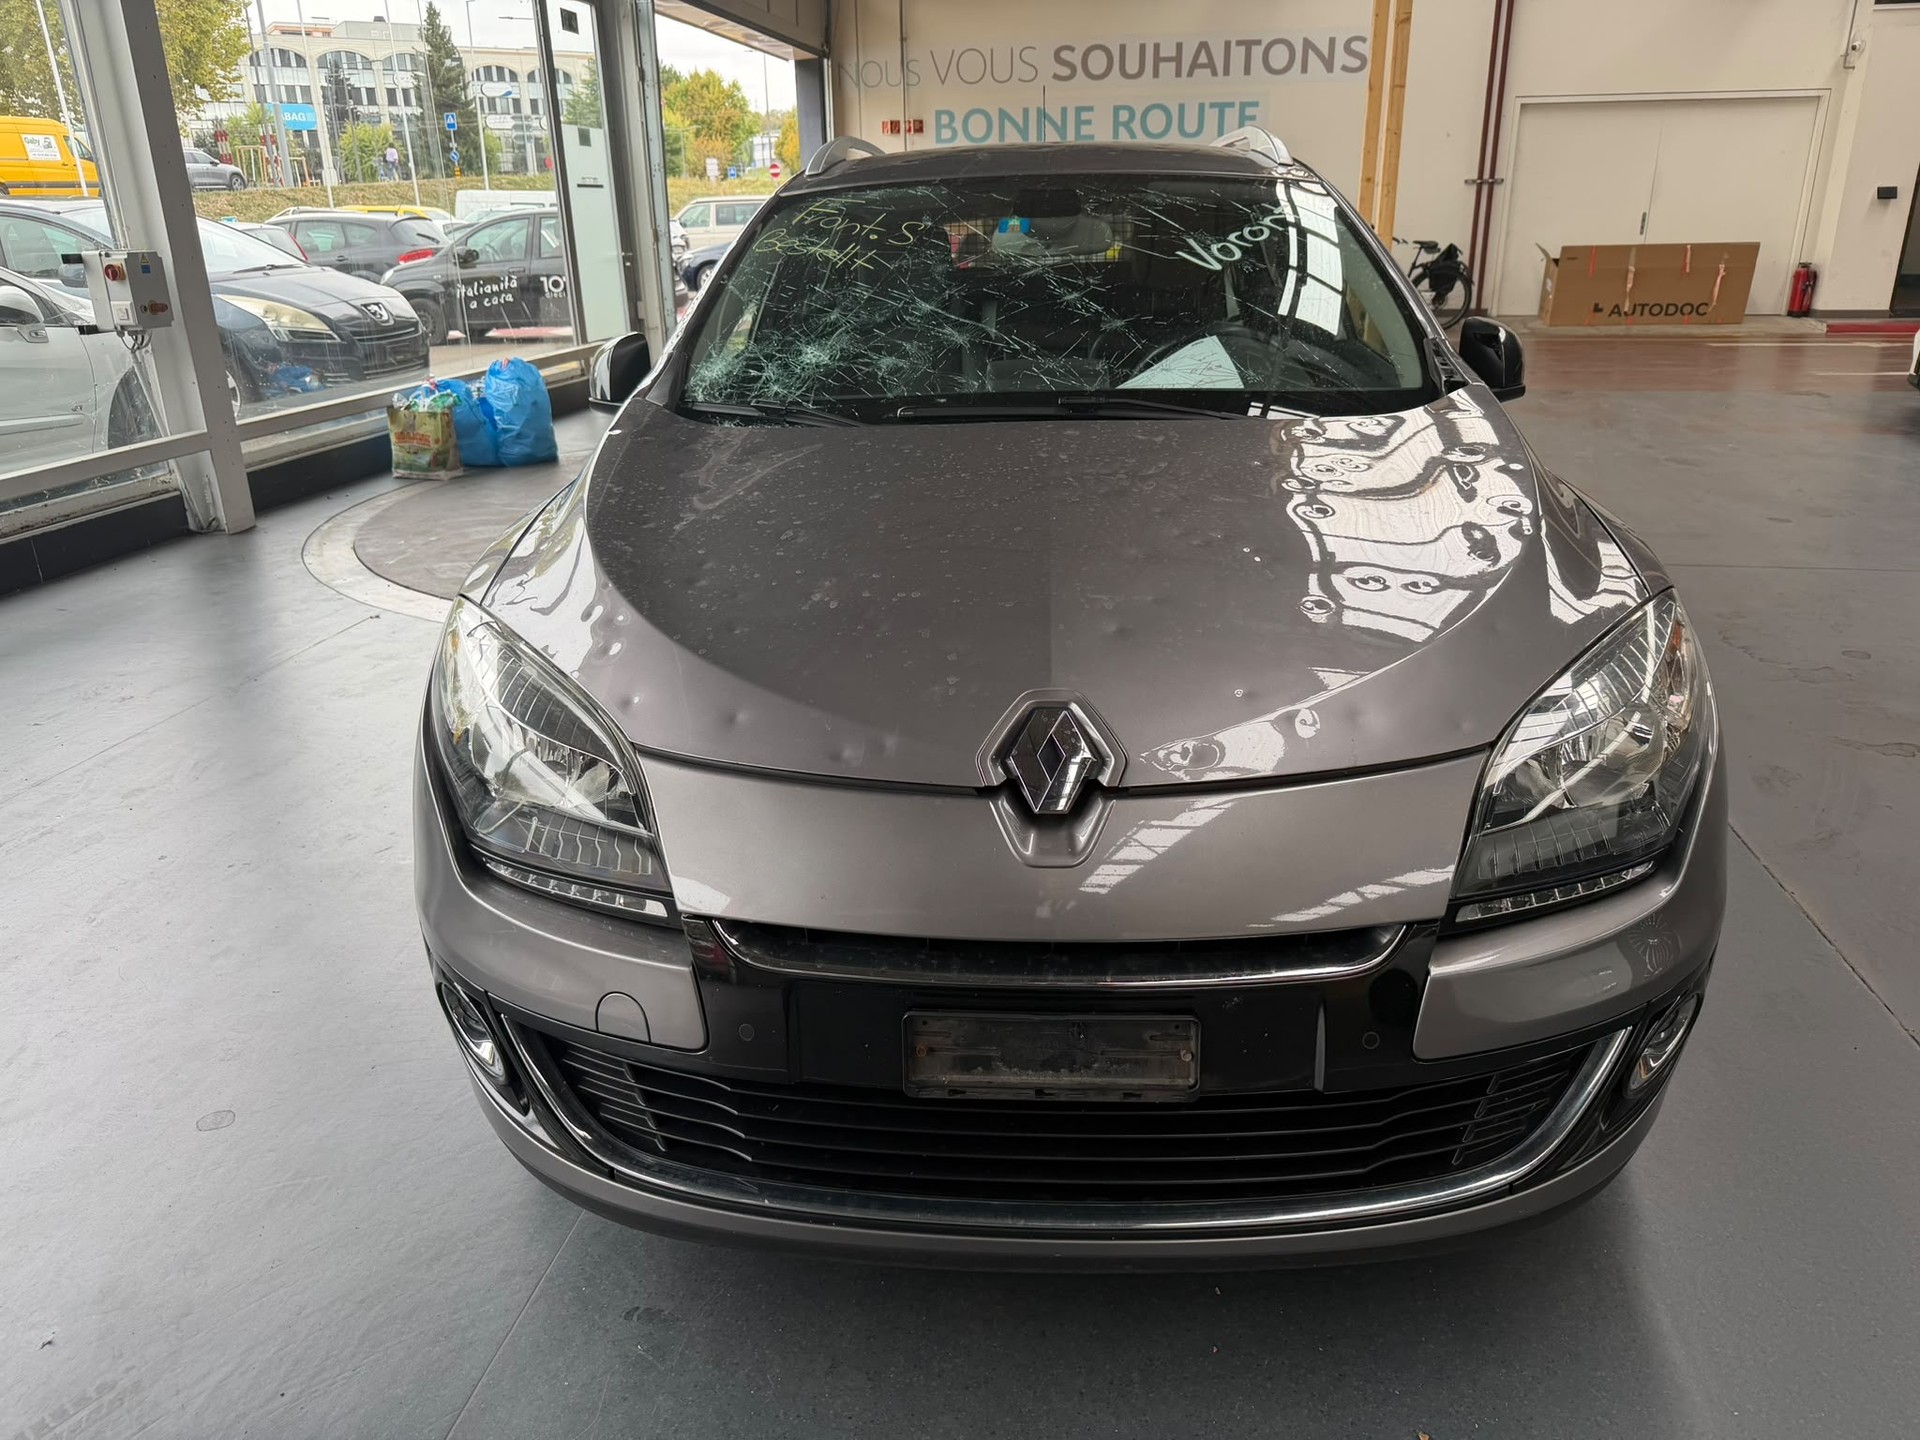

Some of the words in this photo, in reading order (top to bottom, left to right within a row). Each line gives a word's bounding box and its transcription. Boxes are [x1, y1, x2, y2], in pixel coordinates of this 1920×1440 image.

[838, 59, 921, 88] NOUS
[930, 46, 1038, 85] VOUS
[1052, 35, 1369, 82] SOUHAITONS
[281, 112, 306, 121] BAG
[935, 105, 1095, 144] BONNE
[1112, 101, 1260, 140] ROUTE
[457, 275, 518, 298] italianità
[469, 300, 478, 309] a
[483, 293, 514, 307] casa
[1607, 302, 1709, 317] AUTODOC
